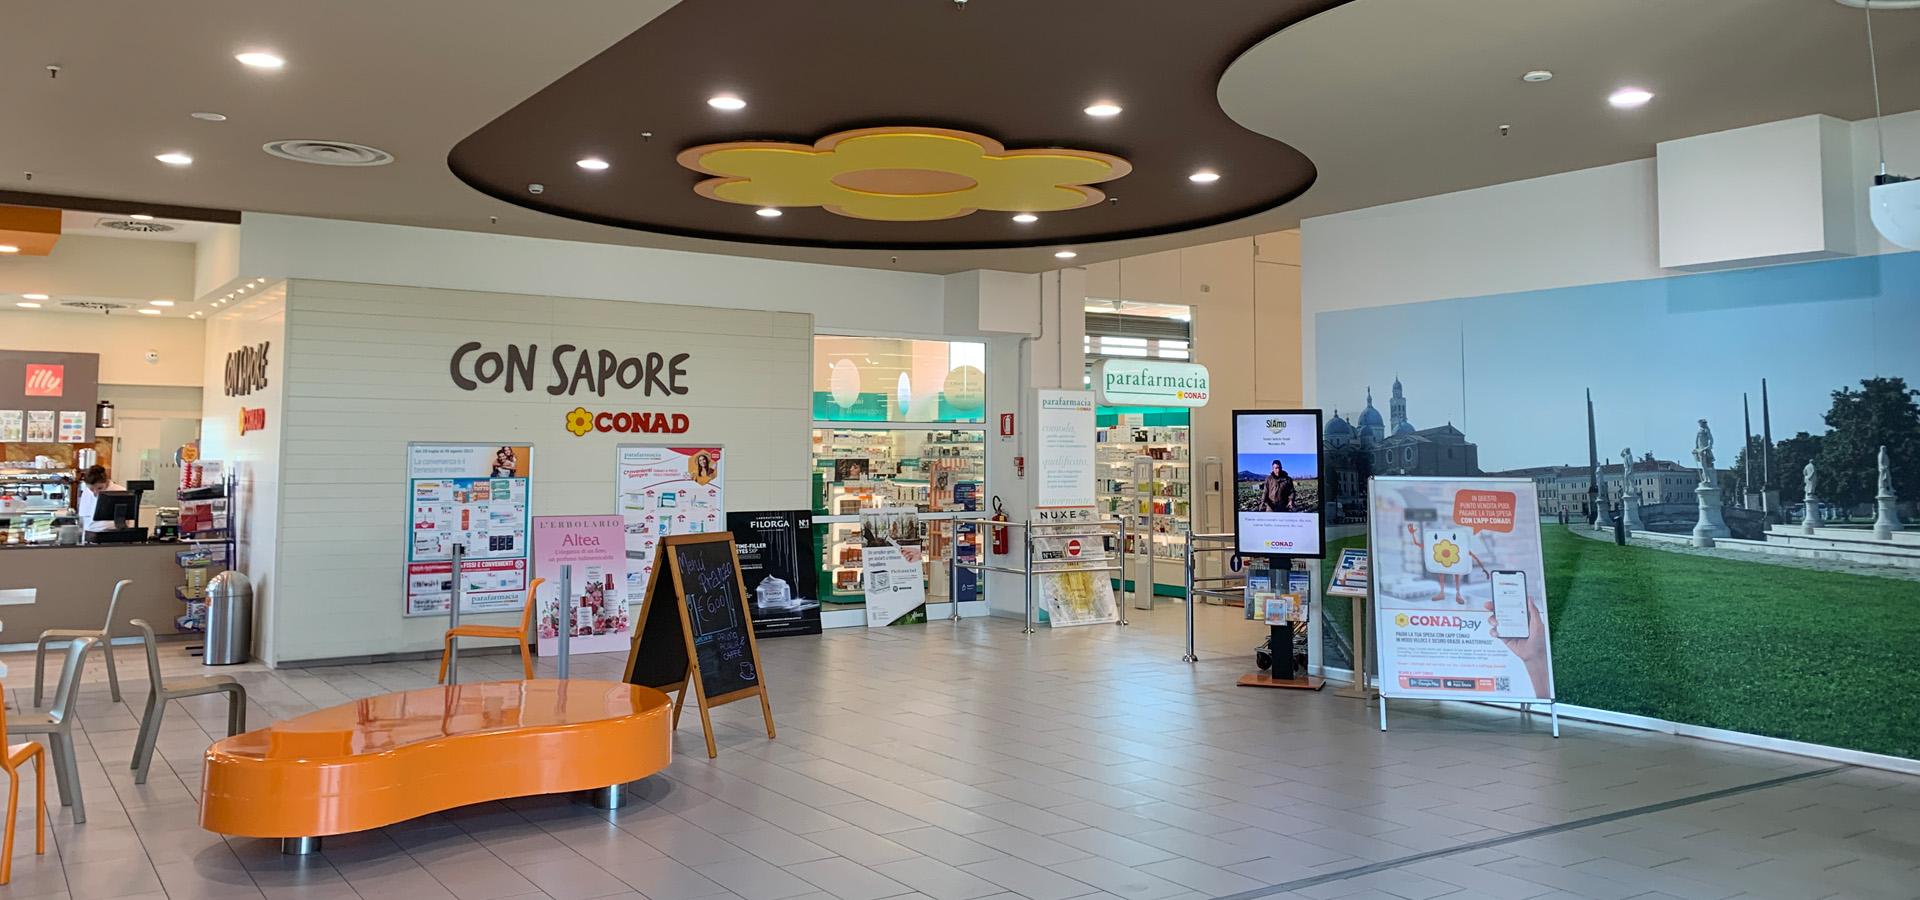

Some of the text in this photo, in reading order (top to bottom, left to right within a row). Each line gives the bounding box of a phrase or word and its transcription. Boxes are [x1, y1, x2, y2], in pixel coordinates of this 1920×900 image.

[450, 341, 690, 397] CON SAPORE
[28, 369, 60, 393] illy
[1106, 368, 1207, 390] parafarmacia
[1183, 392, 1207, 400] CONAD
[1042, 397, 1092, 409] parafarmacia
[594, 412, 690, 434] CONAD
[1040, 510, 1077, 520] NUXE
[540, 520, 620, 529] L'ERBOLARIO
[750, 520, 790, 529] FILORGA
[562, 533, 601, 547] Altea
[1342, 557, 1356, 569] 5
[1250, 581, 1257, 589] 5
[1290, 583, 1297, 591] 5
[1410, 615, 1481, 631] CONAD pay
